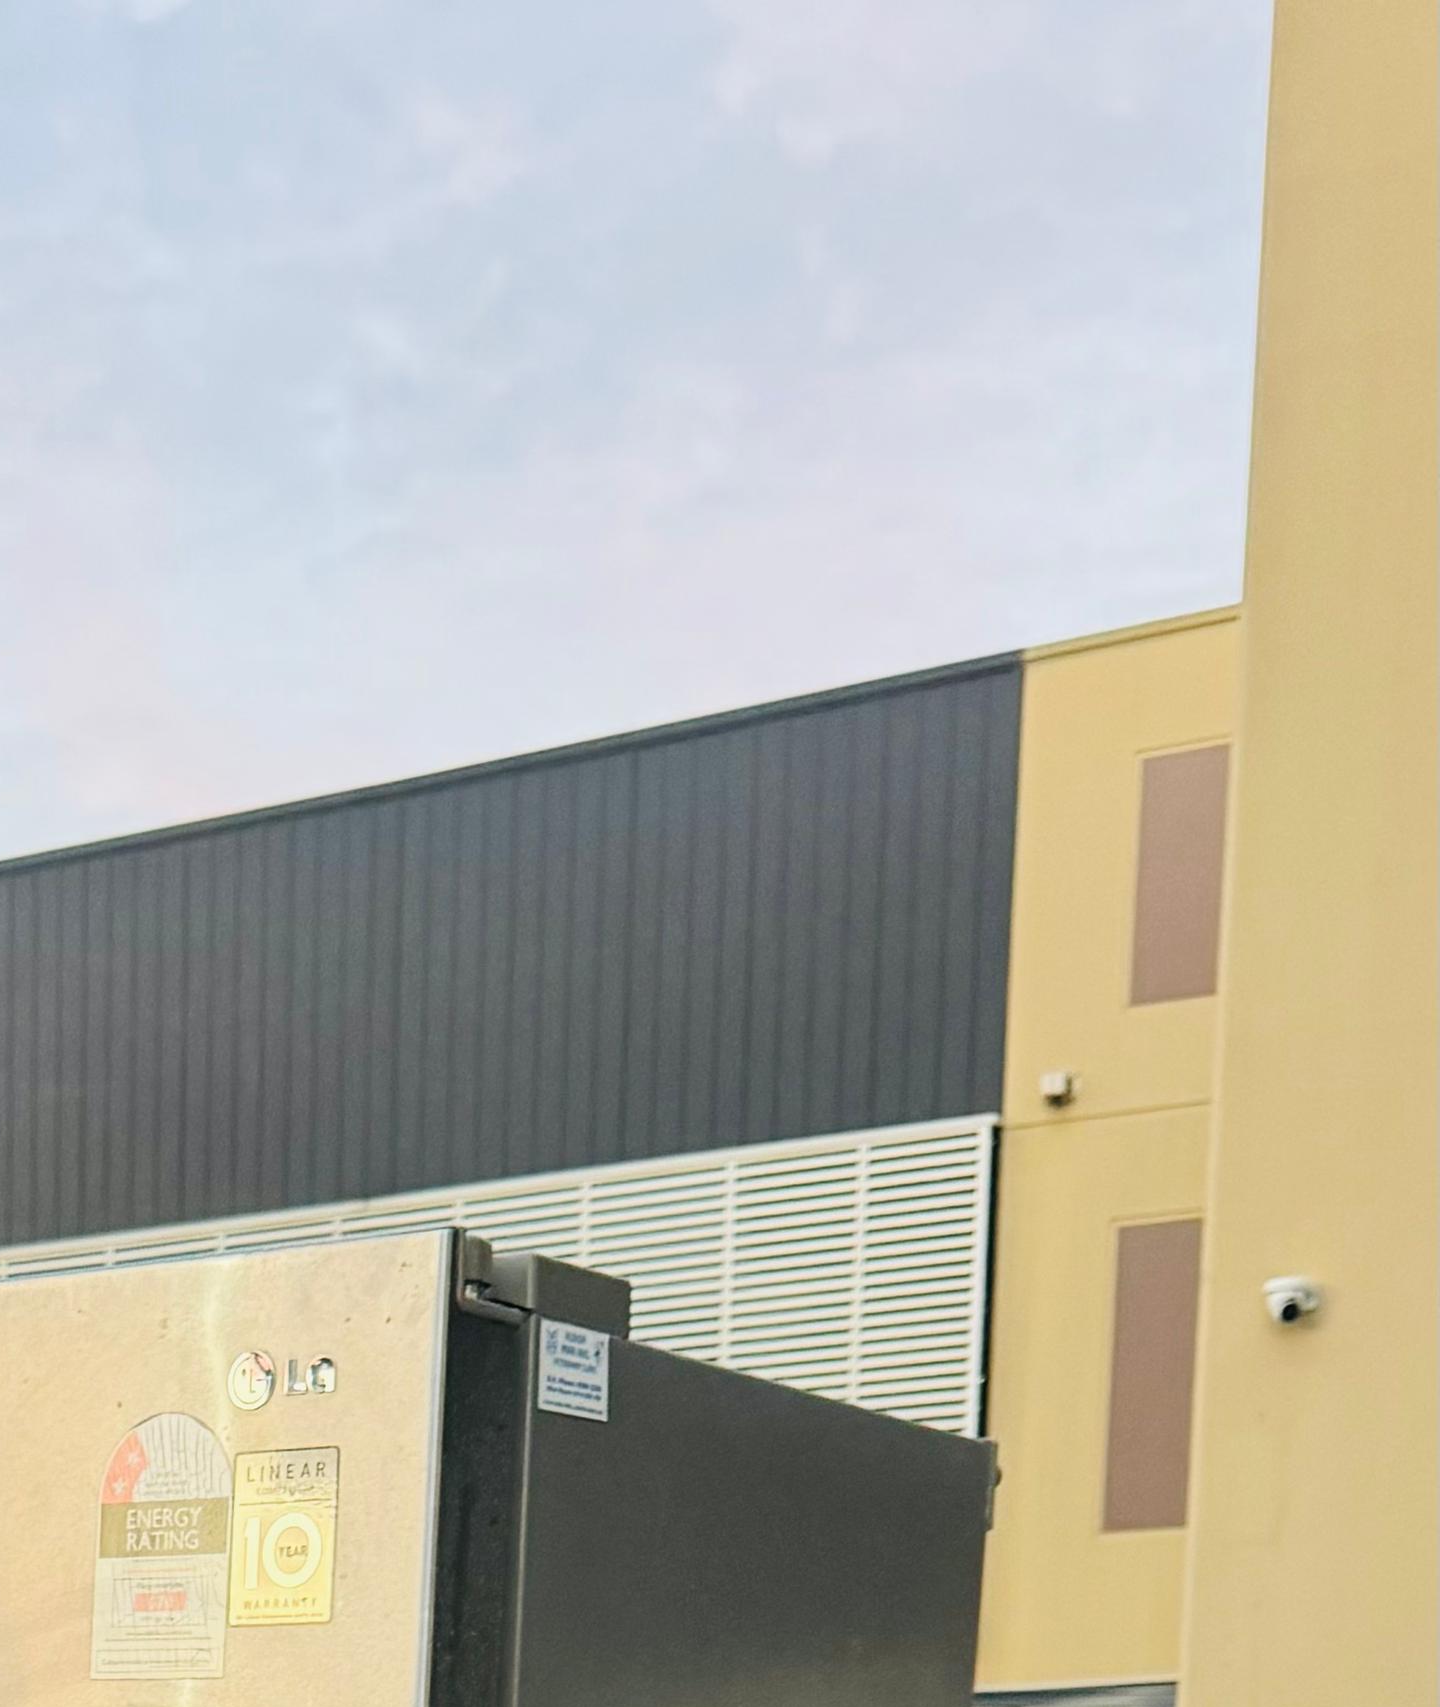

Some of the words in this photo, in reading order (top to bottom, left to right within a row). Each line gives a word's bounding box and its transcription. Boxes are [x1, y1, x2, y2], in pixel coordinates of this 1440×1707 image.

[284, 1357, 337, 1396] LG
[246, 1461, 327, 1483] LINEAR
[125, 1506, 203, 1529] ENERGY
[125, 1530, 200, 1552] RATING
[243, 1511, 324, 1590] 10
